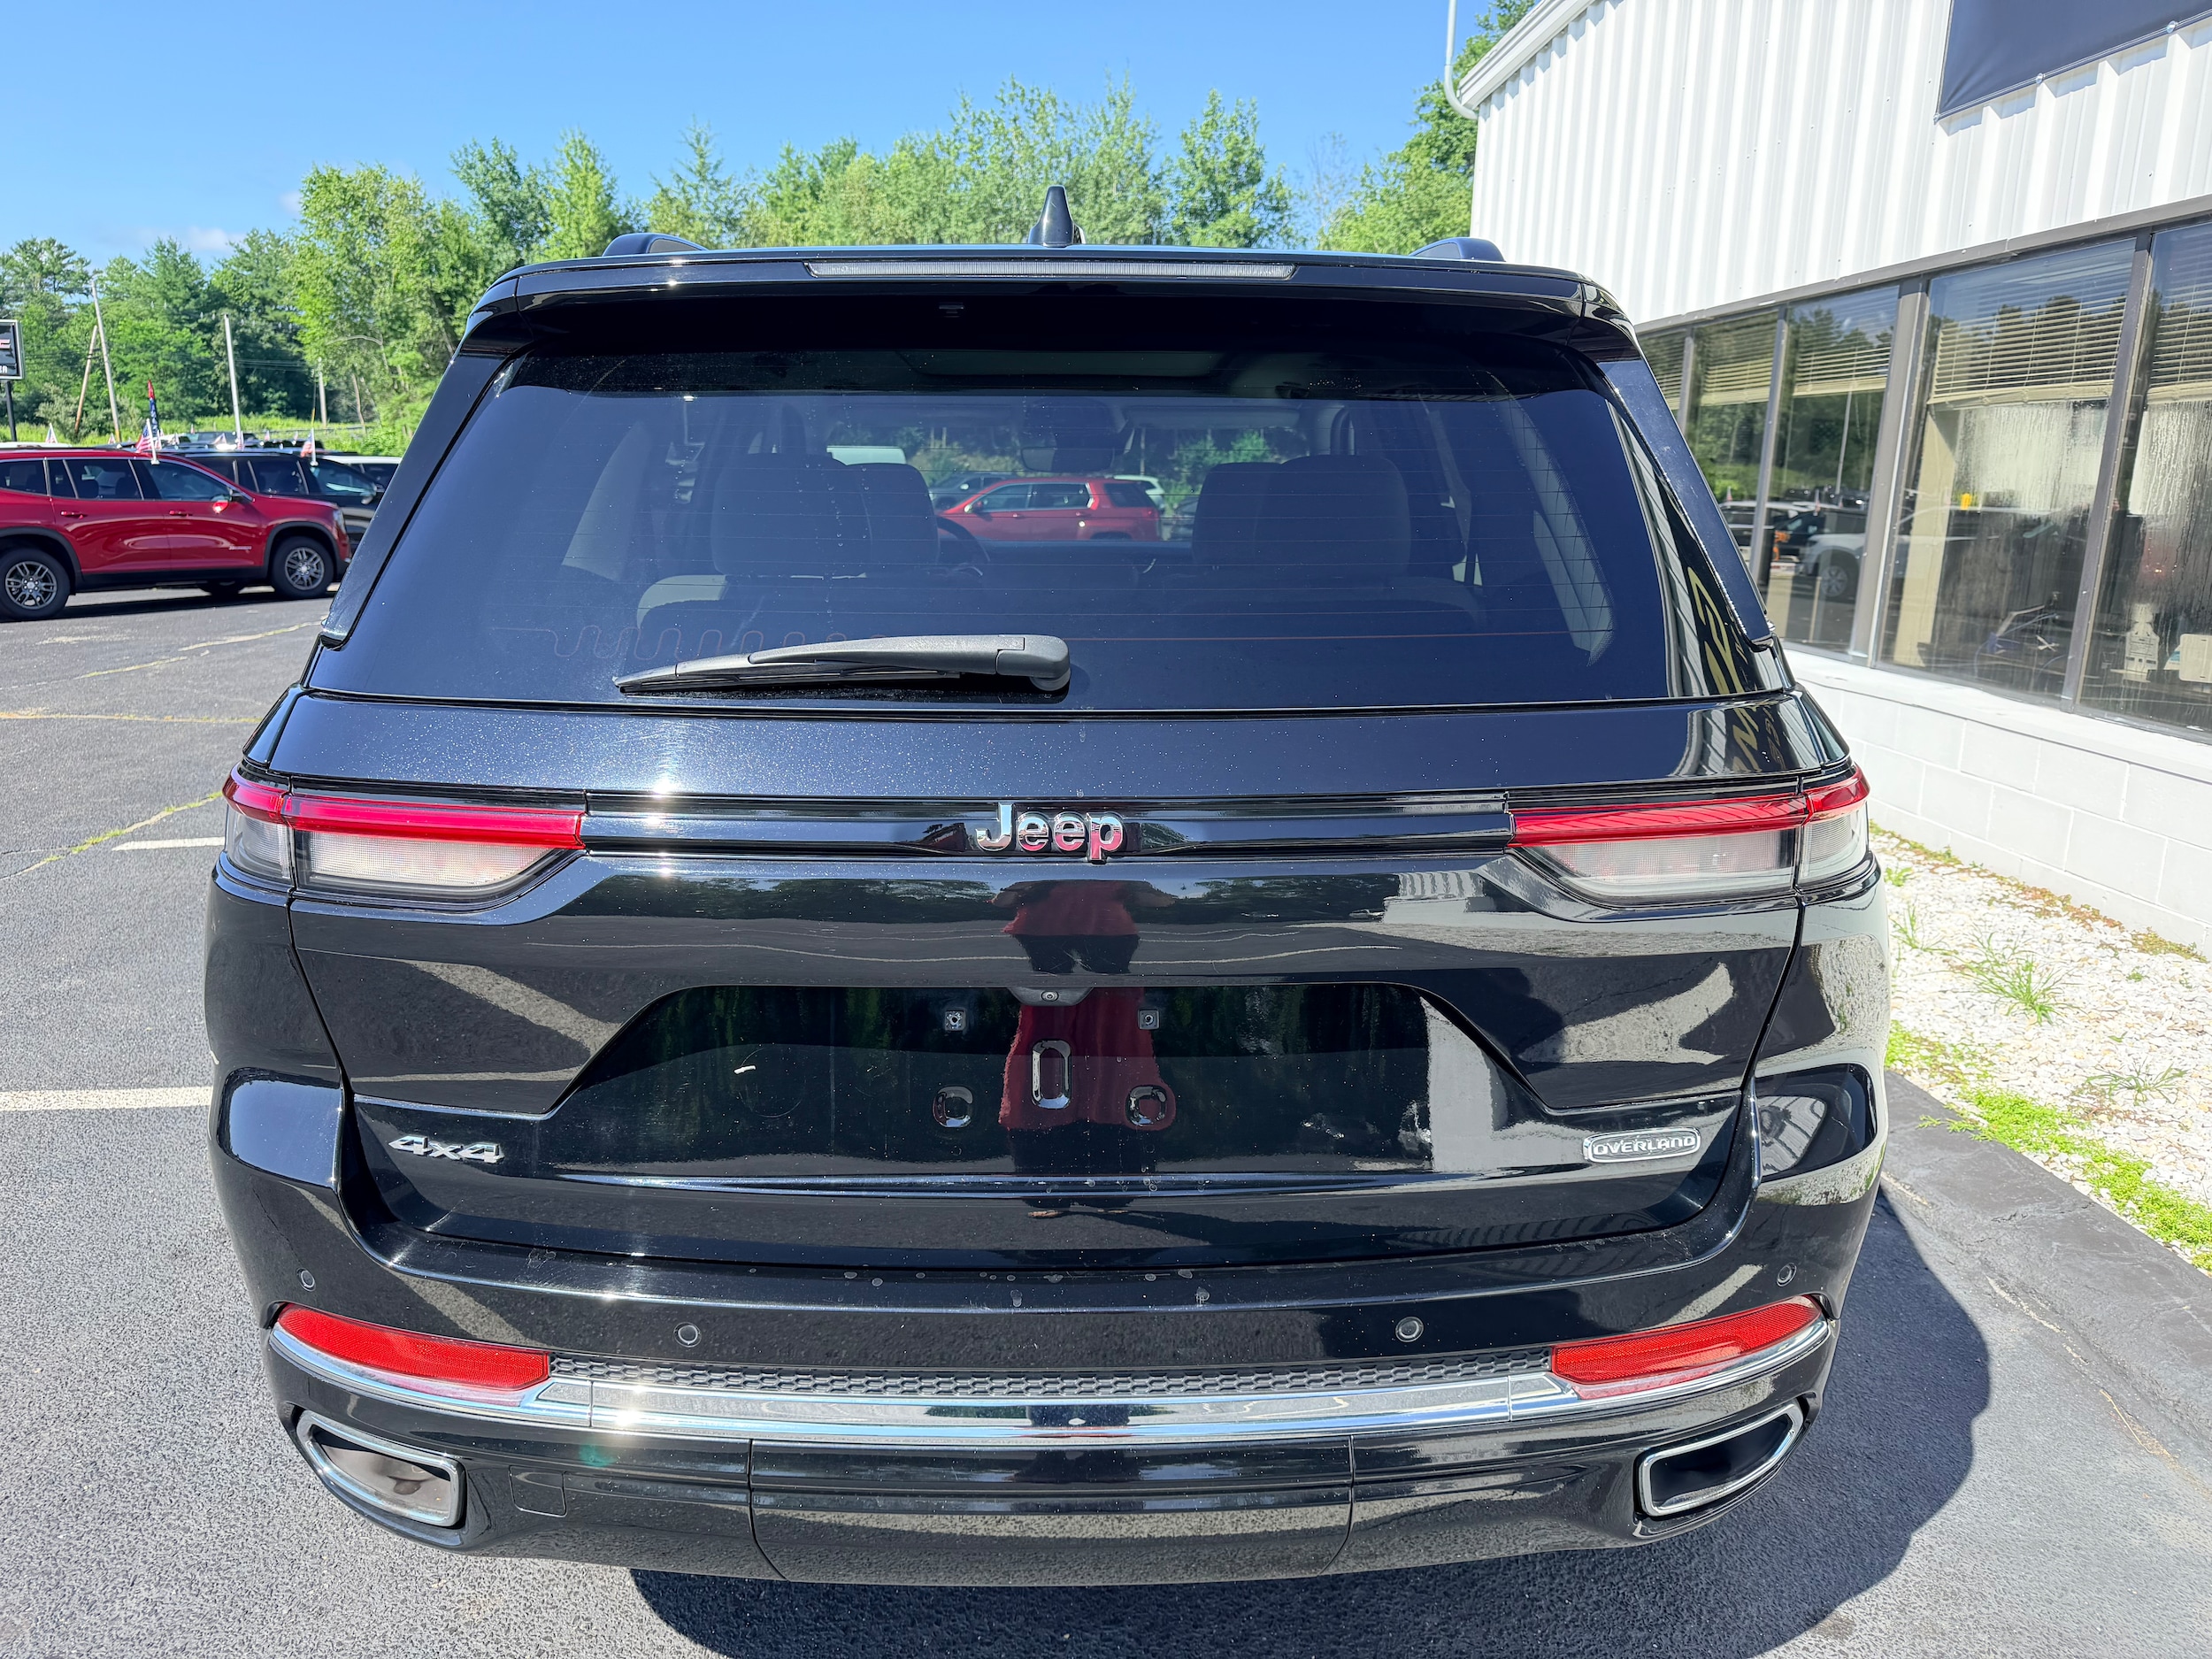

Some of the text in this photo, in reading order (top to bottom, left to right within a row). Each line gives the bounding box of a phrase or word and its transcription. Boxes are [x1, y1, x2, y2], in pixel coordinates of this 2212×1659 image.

[975, 802, 1125, 862] Jeep
[388, 1135, 503, 1164] 4x4
[1593, 1134, 1697, 1156] OVERLAND
